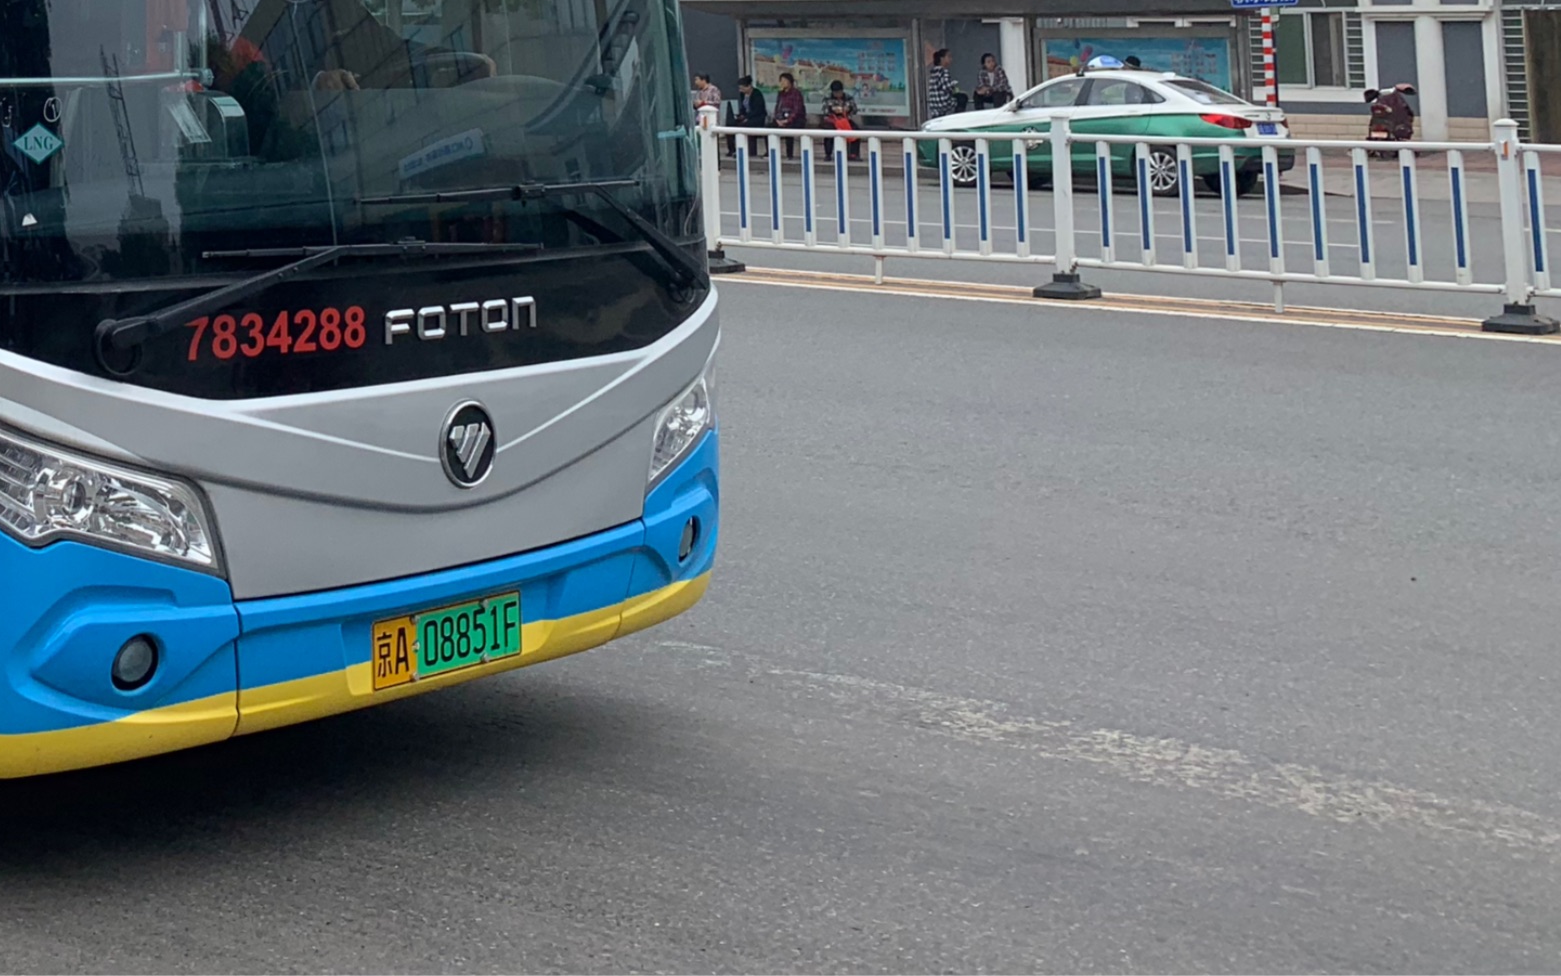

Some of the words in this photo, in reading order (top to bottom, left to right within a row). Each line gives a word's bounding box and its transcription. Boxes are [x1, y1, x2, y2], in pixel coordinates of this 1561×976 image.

[23, 135, 54, 151] LNG
[185, 305, 366, 362] 7834288
[383, 295, 538, 346] FOTON
